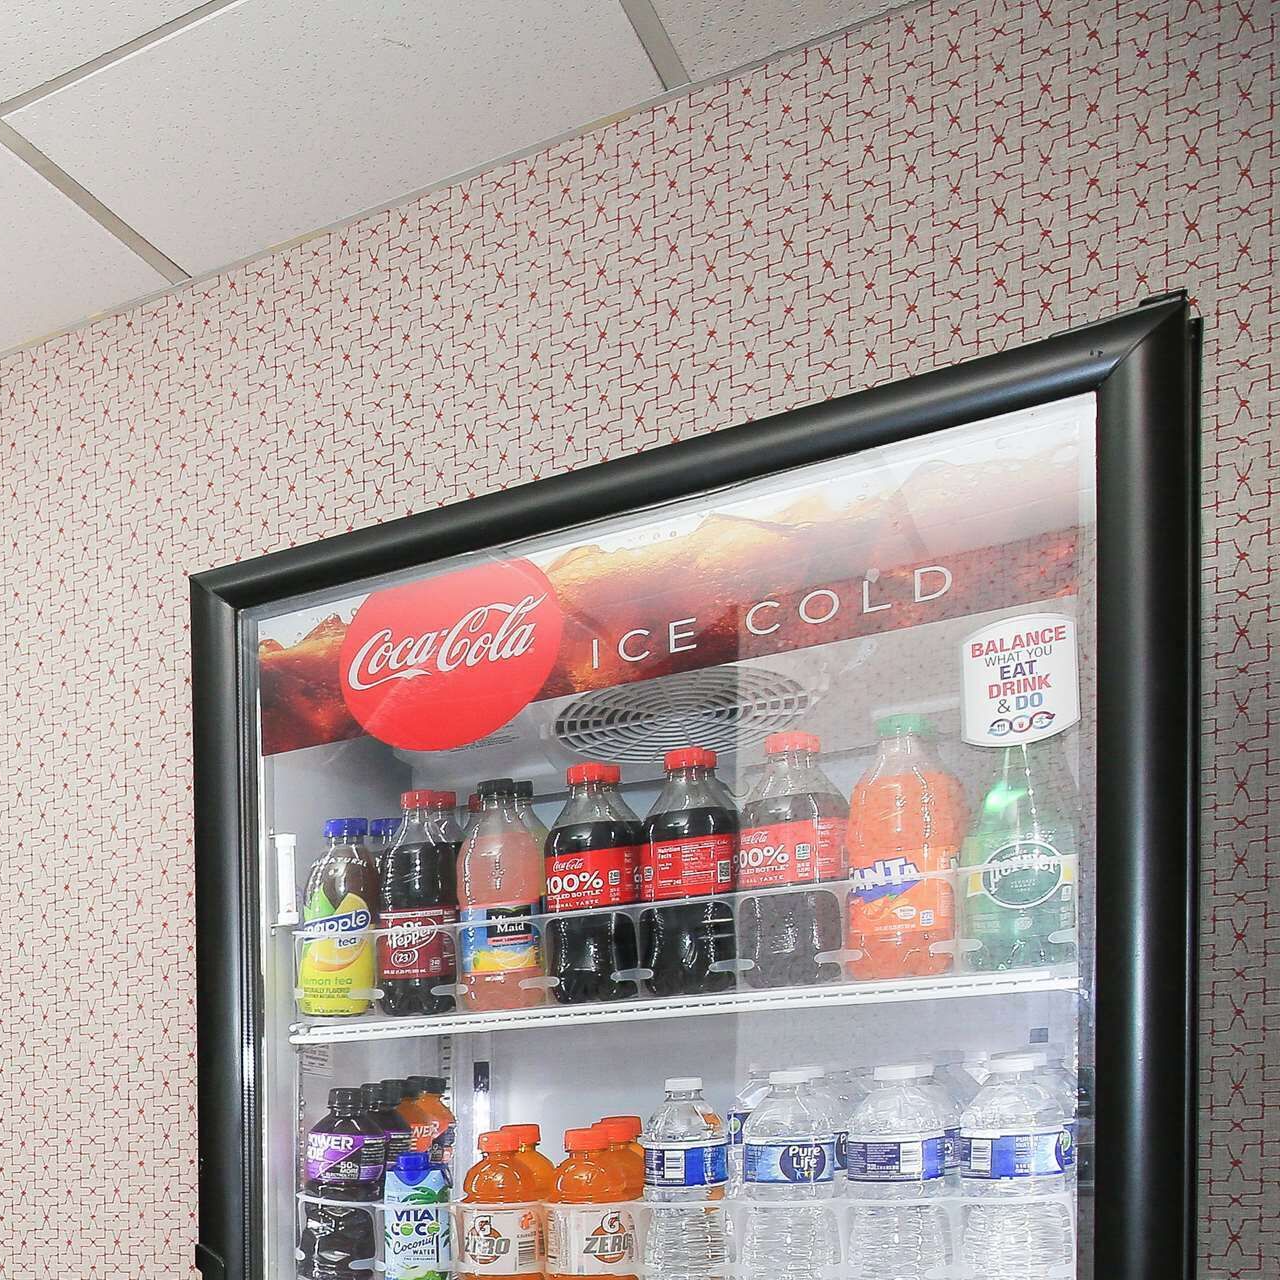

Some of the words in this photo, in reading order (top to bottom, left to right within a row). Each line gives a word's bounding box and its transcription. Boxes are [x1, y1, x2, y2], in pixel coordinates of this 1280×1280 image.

[592, 618, 697, 670] ICE
[746, 566, 952, 635] COLD
[348, 591, 548, 691] Coca-Cola
[971, 625, 1067, 658] BALANCE
[984, 651, 1022, 667] WHAT
[1028, 645, 1052, 657] YOU
[988, 674, 1051, 699] DRINK
[997, 699, 1011, 713] &
[1015, 692, 1043, 710] DO
[740, 844, 789, 868] 00%
[546, 870, 604, 894] 100%
[849, 856, 920, 892] ANTA
[497, 922, 525, 933] Maid
[338, 937, 357, 948] tea
[788, 1145, 821, 1159] Pure
[793, 1154, 818, 1168] Life
[395, 1208, 434, 1221] VITA
[391, 1222, 440, 1237] COCO
[393, 1233, 435, 1254] Coconut
[583, 1236, 630, 1255] ZERO
